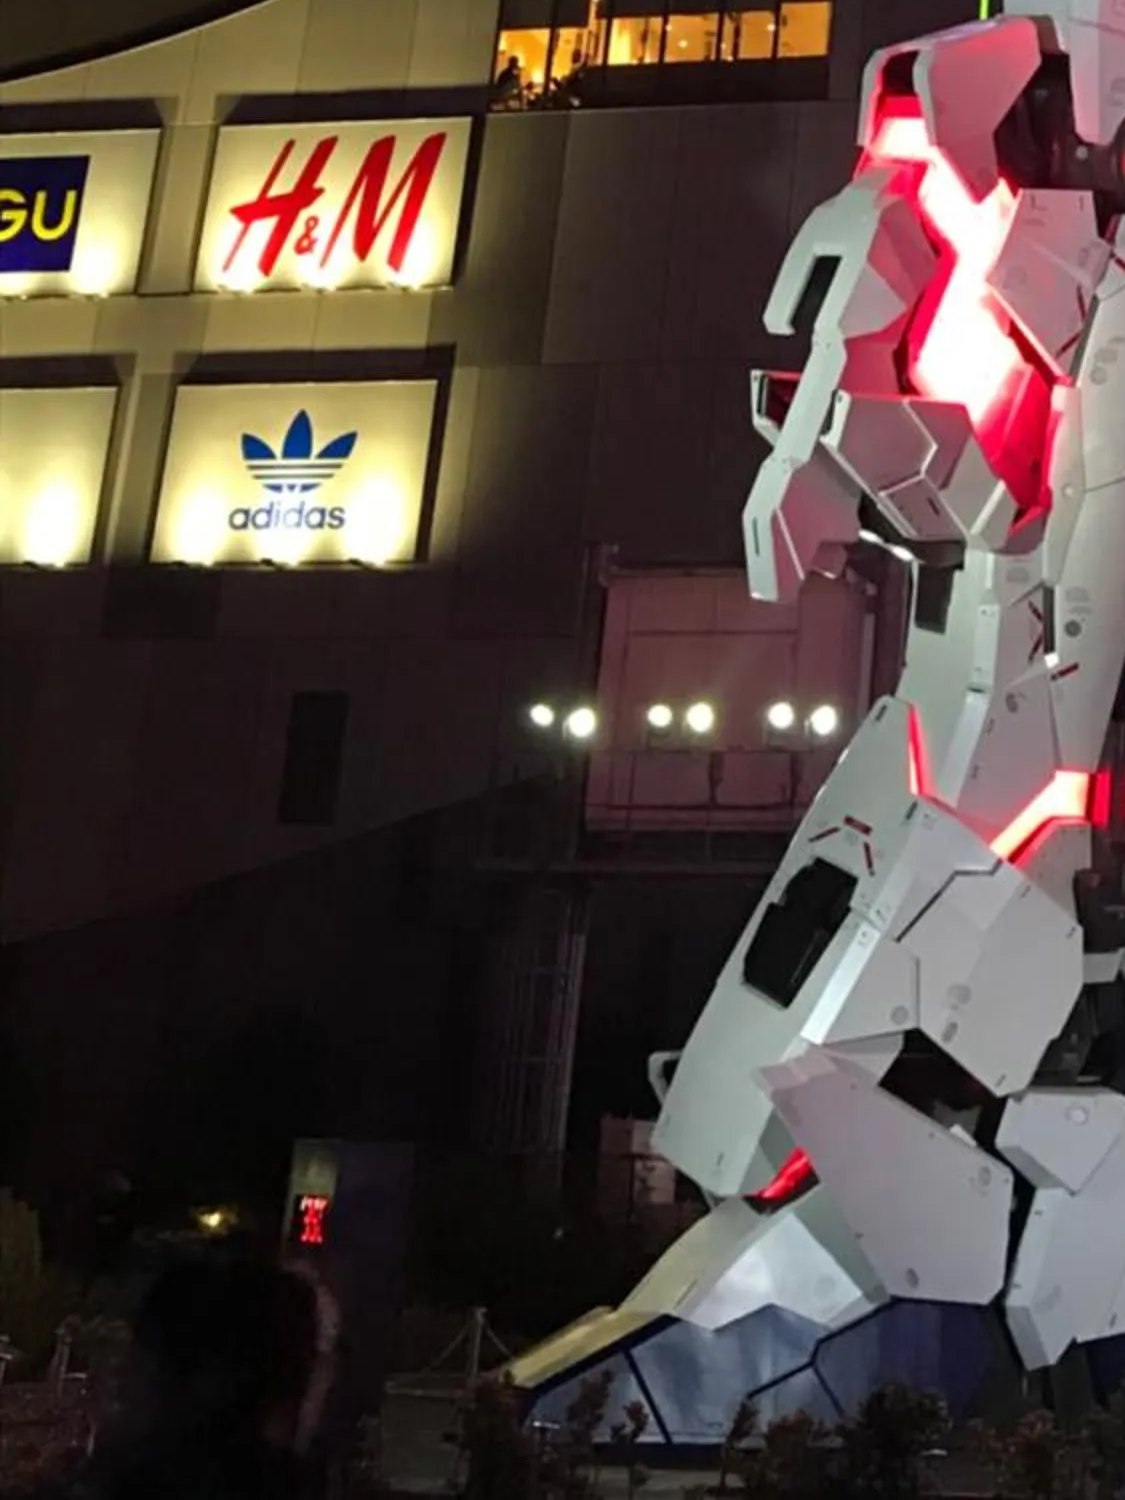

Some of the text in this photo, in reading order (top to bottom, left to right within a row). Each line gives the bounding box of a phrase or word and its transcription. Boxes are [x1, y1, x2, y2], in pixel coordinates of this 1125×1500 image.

[0, 188, 77, 242] GU
[223, 131, 446, 277] H&M
[227, 500, 346, 531] adidas
